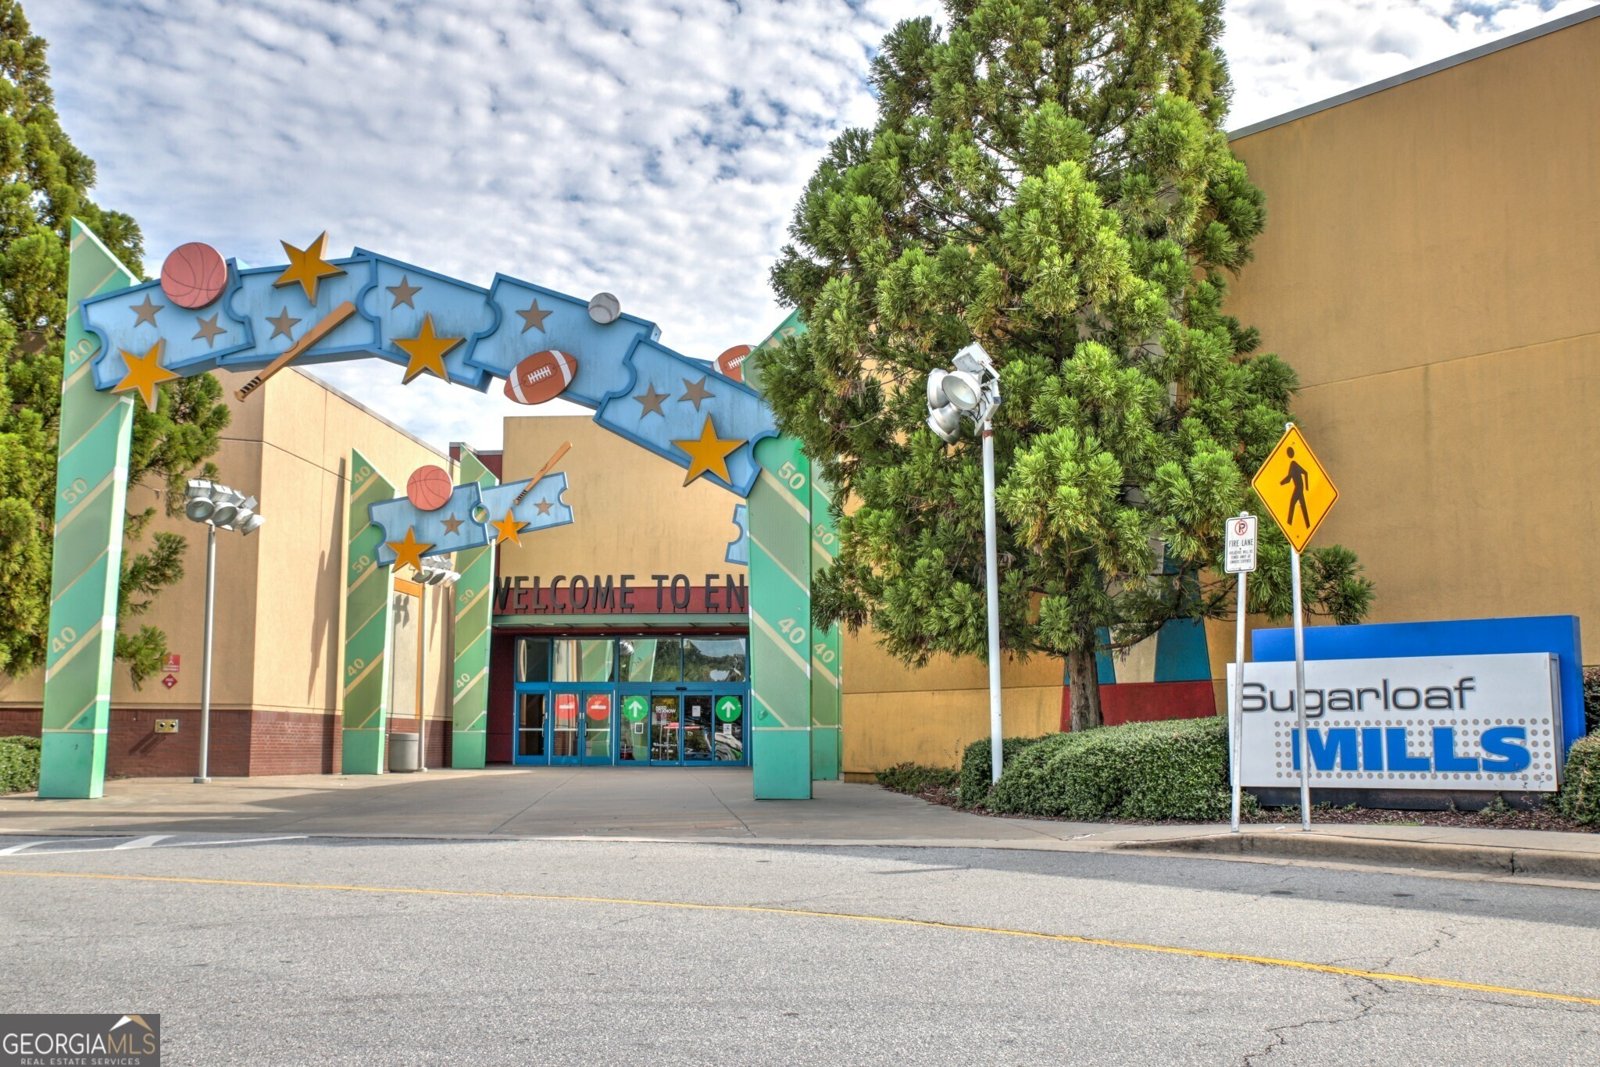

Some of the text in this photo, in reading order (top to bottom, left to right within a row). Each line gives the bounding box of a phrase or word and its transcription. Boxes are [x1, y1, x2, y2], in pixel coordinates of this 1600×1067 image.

[68, 338, 93, 365] 40
[353, 465, 371, 484] 40
[777, 461, 805, 491] 50
[62, 478, 88, 505] 50
[813, 523, 835, 546] 50
[1229, 540, 1239, 548] FIRE
[351, 555, 370, 574] 50
[493, 574, 635, 610] WELCOME
[651, 574, 690, 609] TO
[51, 626, 76, 654] 40
[777, 617, 806, 645] 40
[813, 642, 835, 664] 40
[347, 658, 365, 677] 40
[456, 673, 470, 690] 40
[1242, 676, 1475, 718] Sugarloaf
[1292, 726, 1531, 773] MILLS
